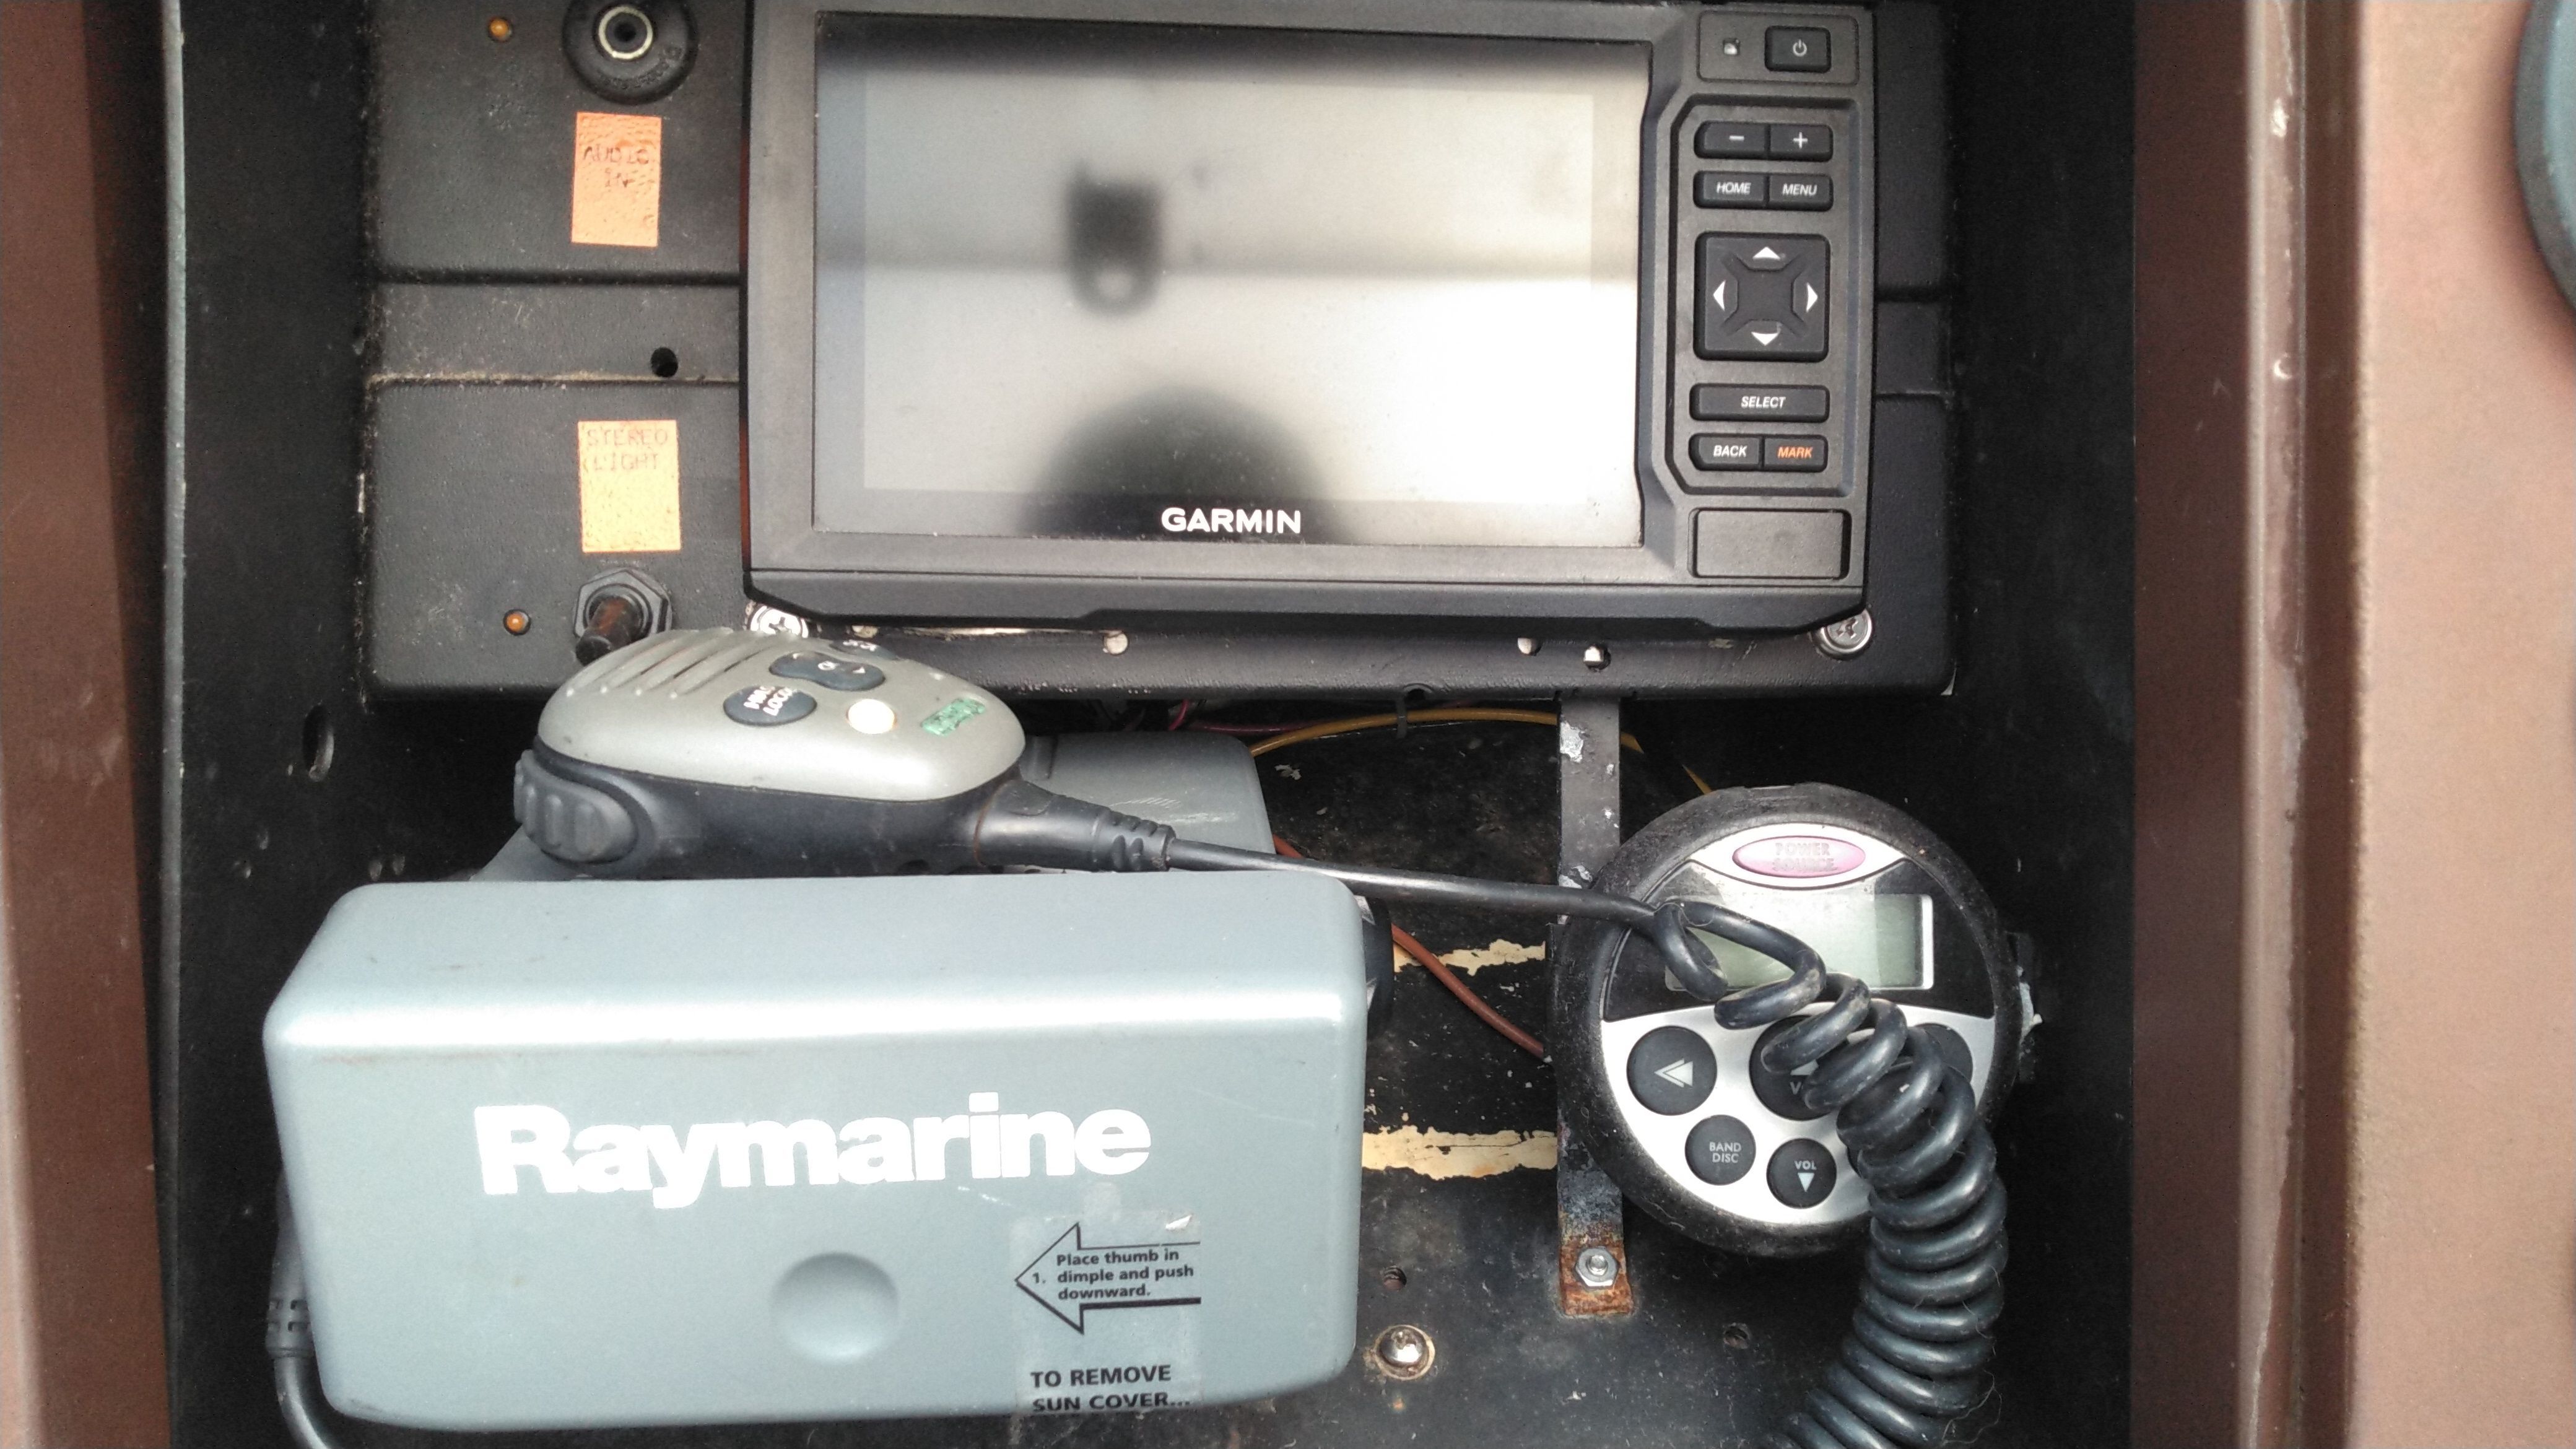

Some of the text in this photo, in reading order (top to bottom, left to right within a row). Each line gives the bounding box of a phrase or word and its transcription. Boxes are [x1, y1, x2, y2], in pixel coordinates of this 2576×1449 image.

[1716, 181, 1752, 195] HOME
[1782, 183, 1818, 196] MENU
[1740, 396, 1786, 409] SELECT
[587, 429, 668, 446] STEREO
[1713, 445, 1747, 458] BACK
[1777, 446, 1814, 459] MARK
[1160, 507, 1301, 534] GARMIN
[1774, 842, 1830, 856] POWER
[474, 1092, 1152, 1209] Raymarine
[1708, 1142, 1743, 1152] BAND
[1712, 1153, 1739, 1164] DISC
[1795, 1160, 1817, 1170] VOL
[1056, 1248, 1180, 1266] Place thumb in
[1032, 1264, 1194, 1287] 1. dimple and push
[1058, 1284, 1151, 1300] downward.
[1030, 1365, 1172, 1388] TO REMOVE
[1032, 1392, 1191, 1412] SUN COVER...
